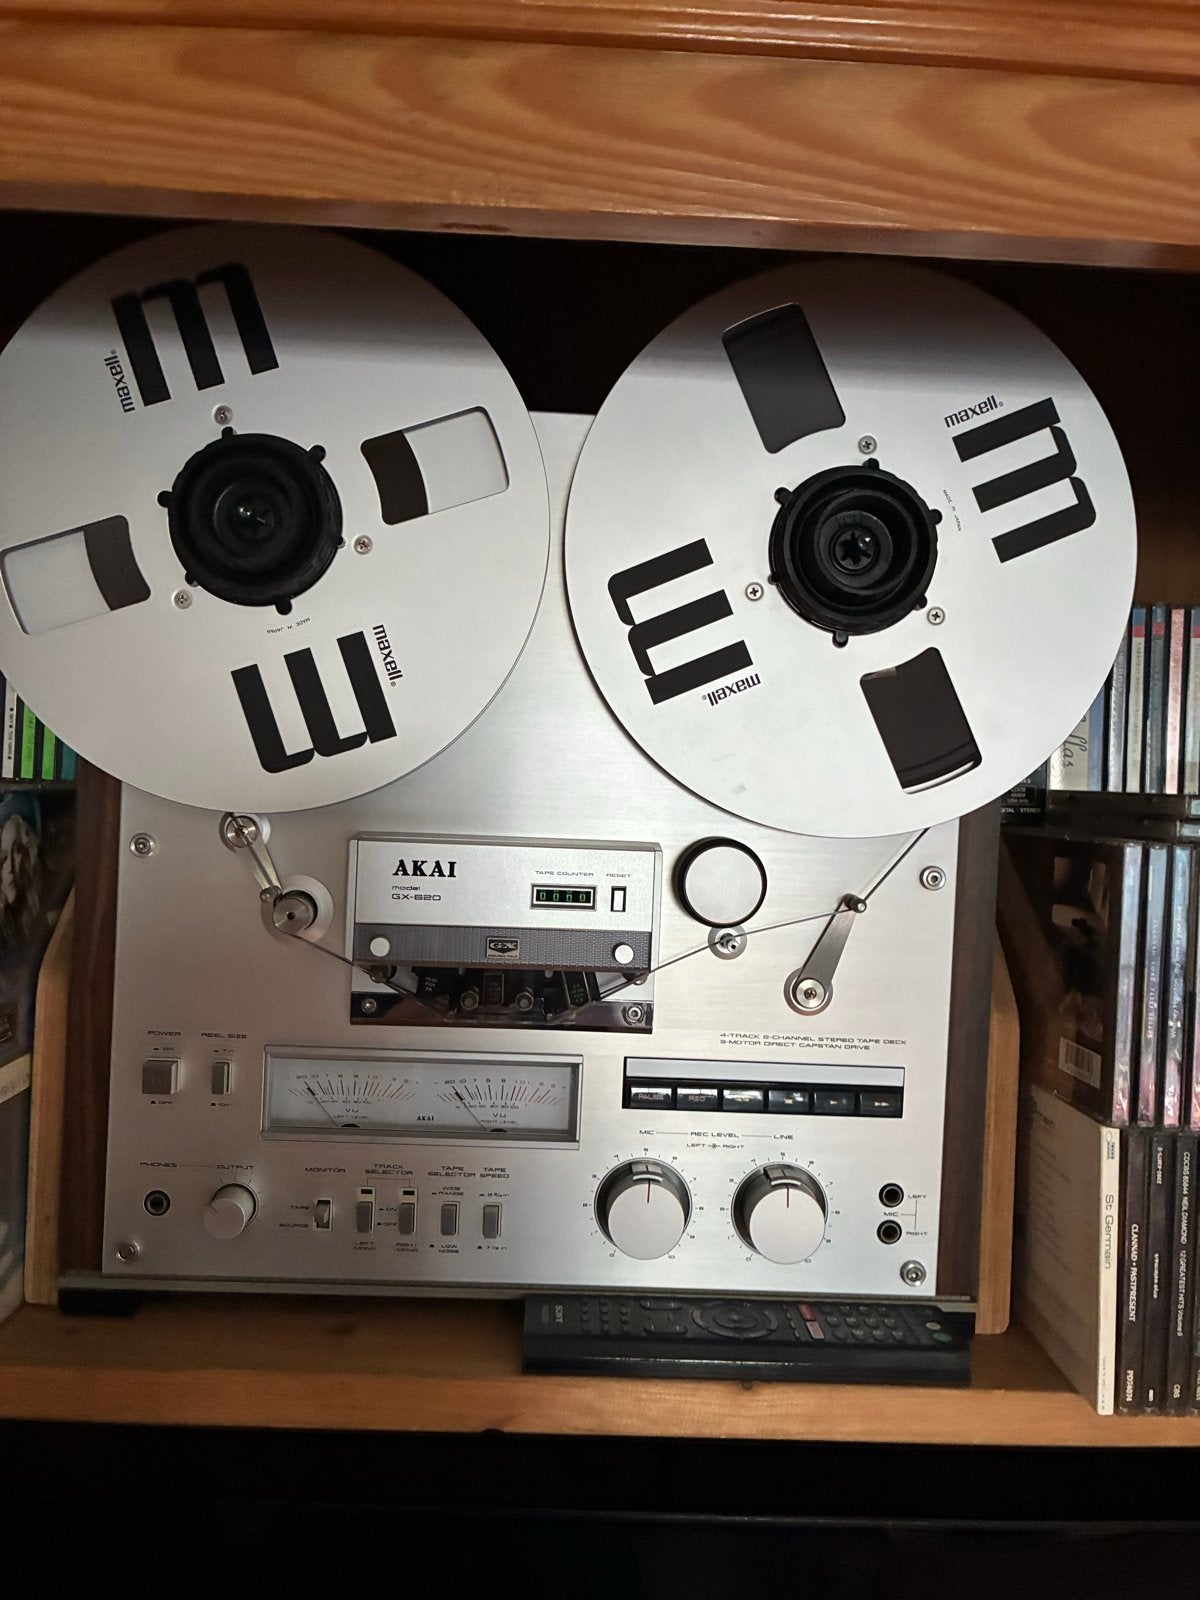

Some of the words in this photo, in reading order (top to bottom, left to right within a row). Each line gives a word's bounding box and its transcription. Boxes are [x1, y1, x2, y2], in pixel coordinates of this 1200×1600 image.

[104, 355, 135, 413] maxell
[944, 395, 999, 428] maxell
[372, 624, 403, 681] maxell
[707, 673, 761, 706] maxell
[392, 859, 457, 878] AKAI
[392, 893, 441, 901] GX-620
[490, 941, 518, 950] GX
[1105, 1194, 1114, 1211] St
[1181, 1196, 1189, 1212] NEIL
[1104, 1215, 1114, 1270] Germain
[1130, 1223, 1139, 1262] CLANNAD
[1180, 1212, 1189, 1245] DIAMOND
[1178, 1257, 1187, 1294] GREATEST
[1128, 1266, 1138, 1322] PASTPRESENT
[1177, 1293, 1185, 1310] HITS
